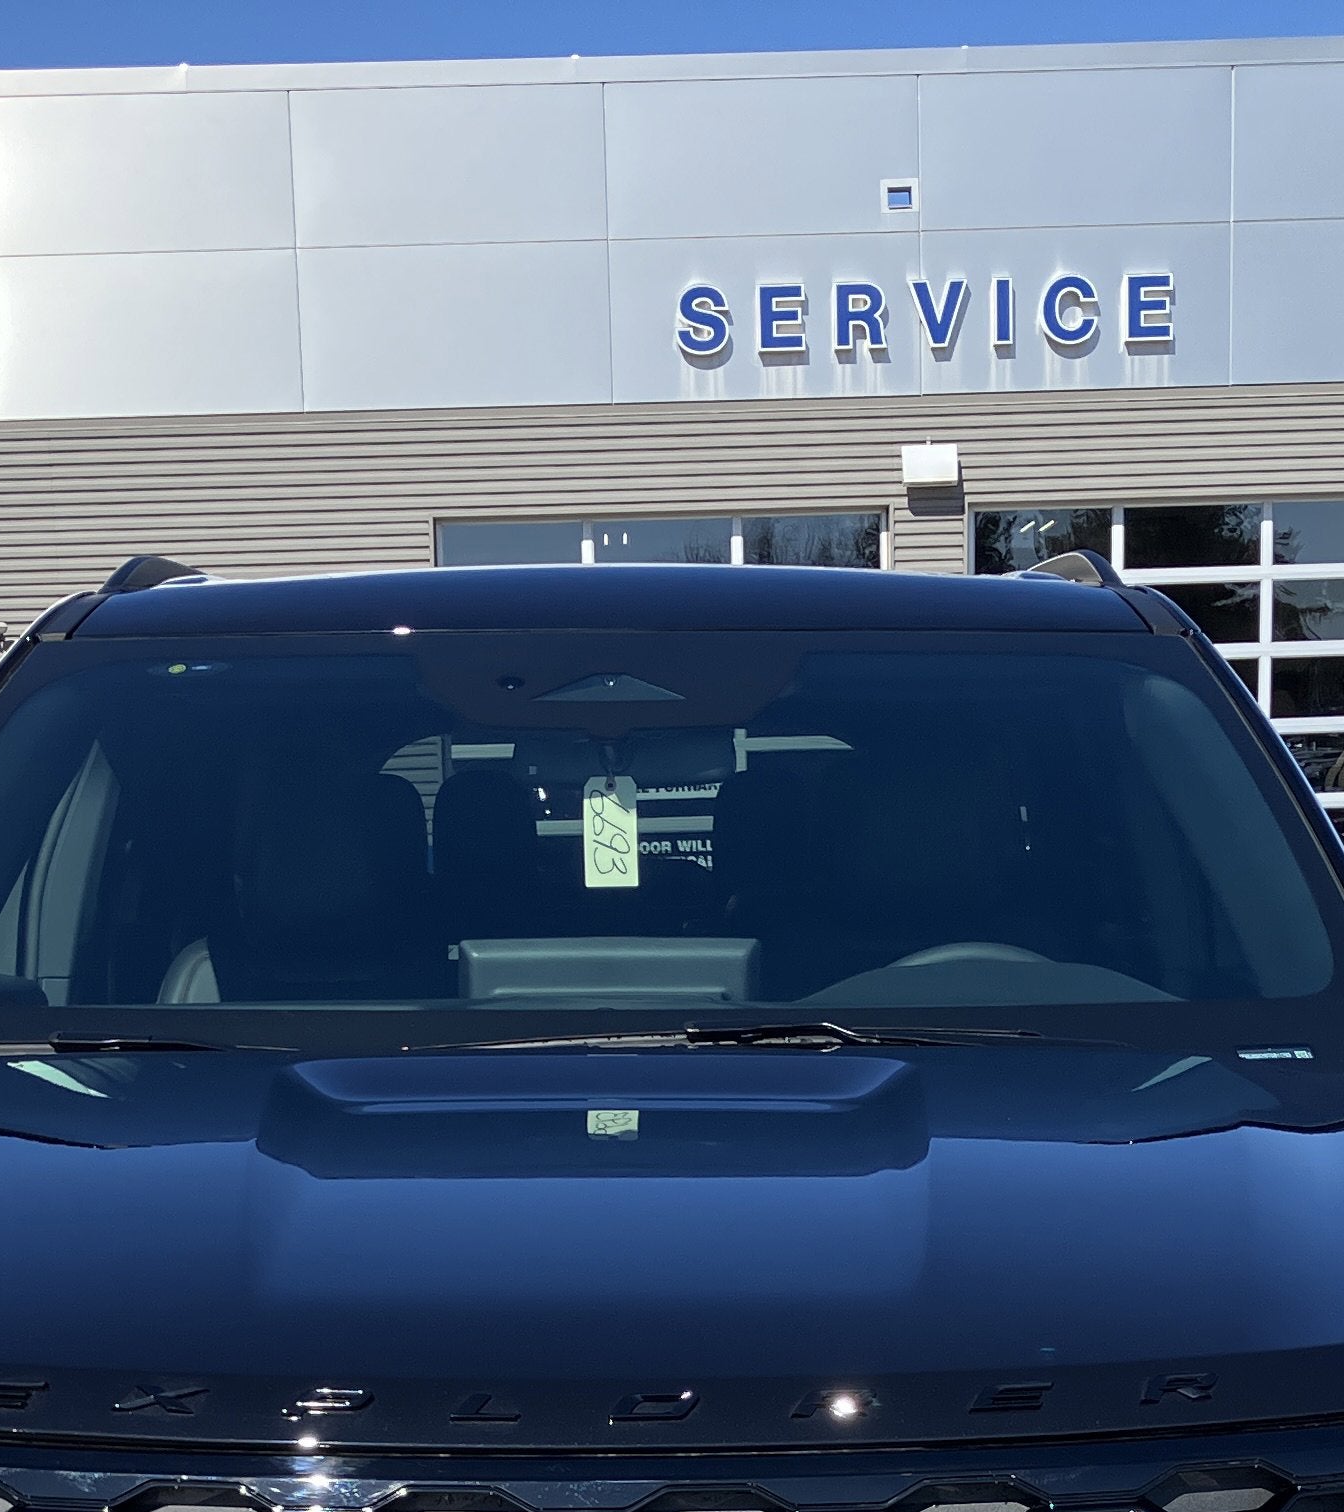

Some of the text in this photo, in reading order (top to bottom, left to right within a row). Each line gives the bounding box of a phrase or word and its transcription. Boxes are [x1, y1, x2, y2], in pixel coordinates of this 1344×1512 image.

[676, 272, 1174, 356] SERVICE
[589, 789, 631, 875] 6693
[639, 839, 713, 854] OOR WILL
